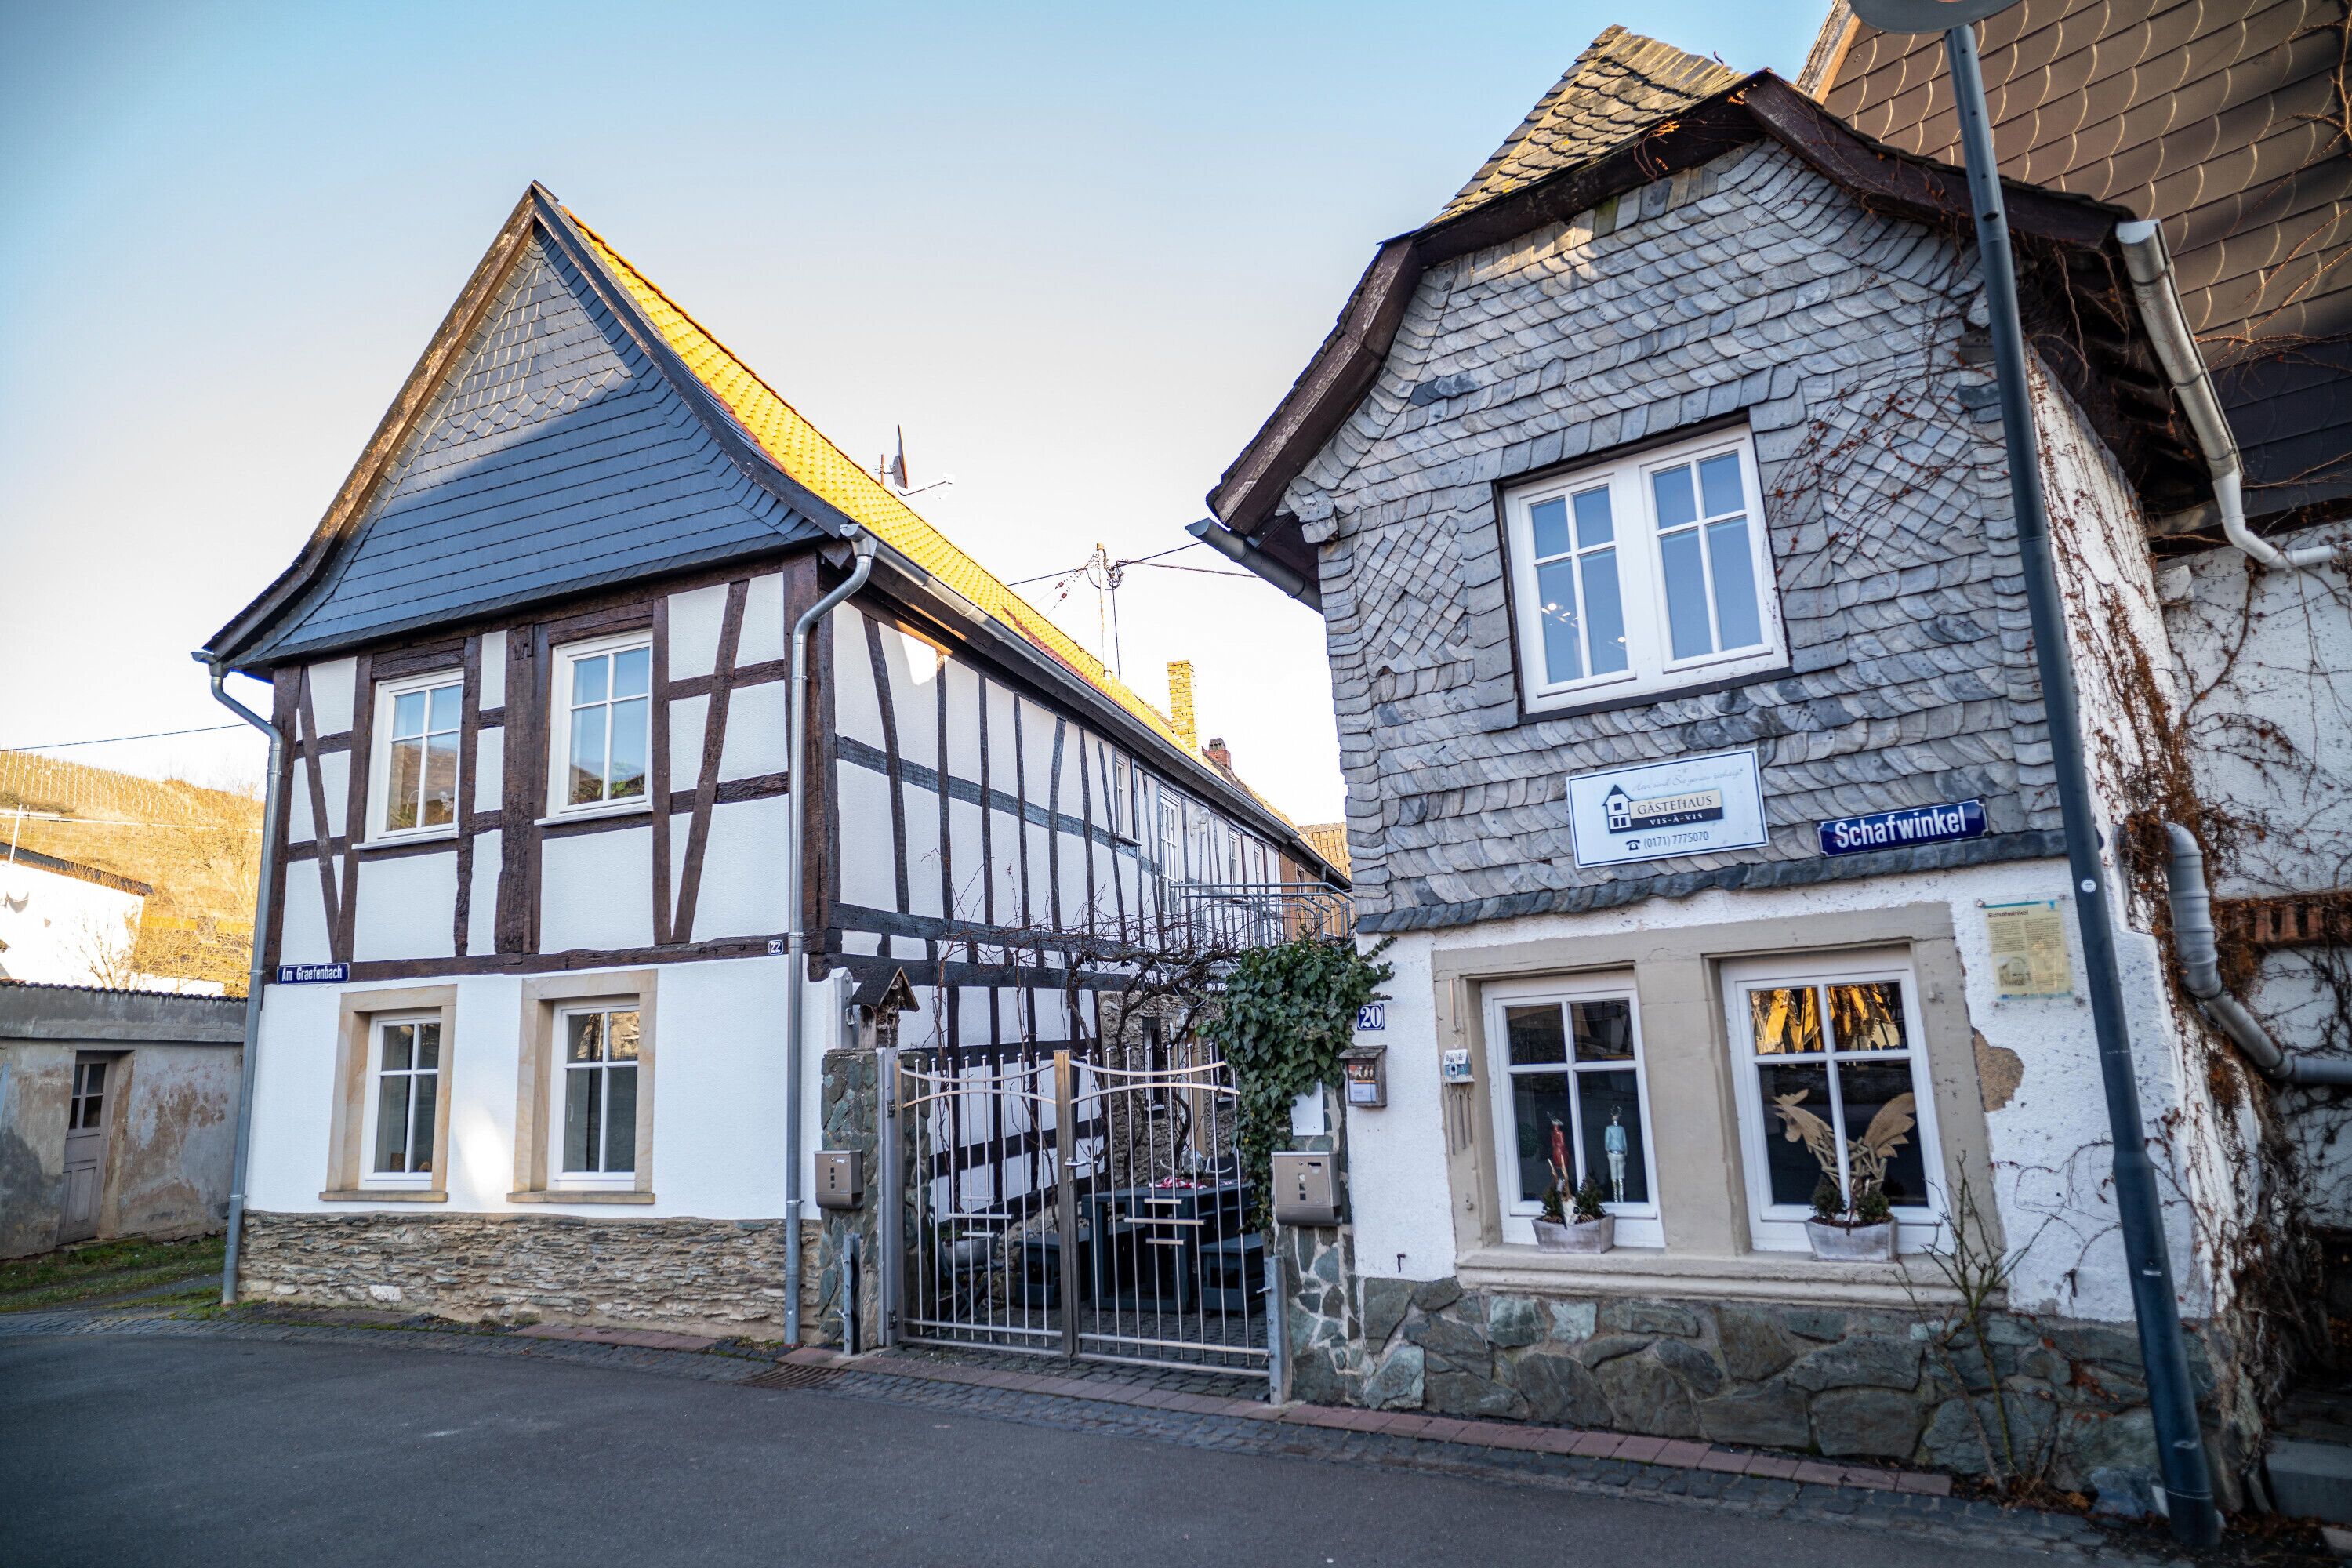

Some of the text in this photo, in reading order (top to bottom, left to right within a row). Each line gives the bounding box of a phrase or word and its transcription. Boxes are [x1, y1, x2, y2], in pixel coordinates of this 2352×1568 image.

[1637, 795, 1712, 815] GÄSTEHAUS
[1650, 812, 1703, 826] VIS-À-VIS
[1834, 805, 1967, 848] Schafwinkel
[1643, 831, 1709, 849] (0171) 7775070
[770, 941, 781, 953] 22
[281, 965, 343, 981] Am Graefenbach
[1359, 1006, 1381, 1028] 20
